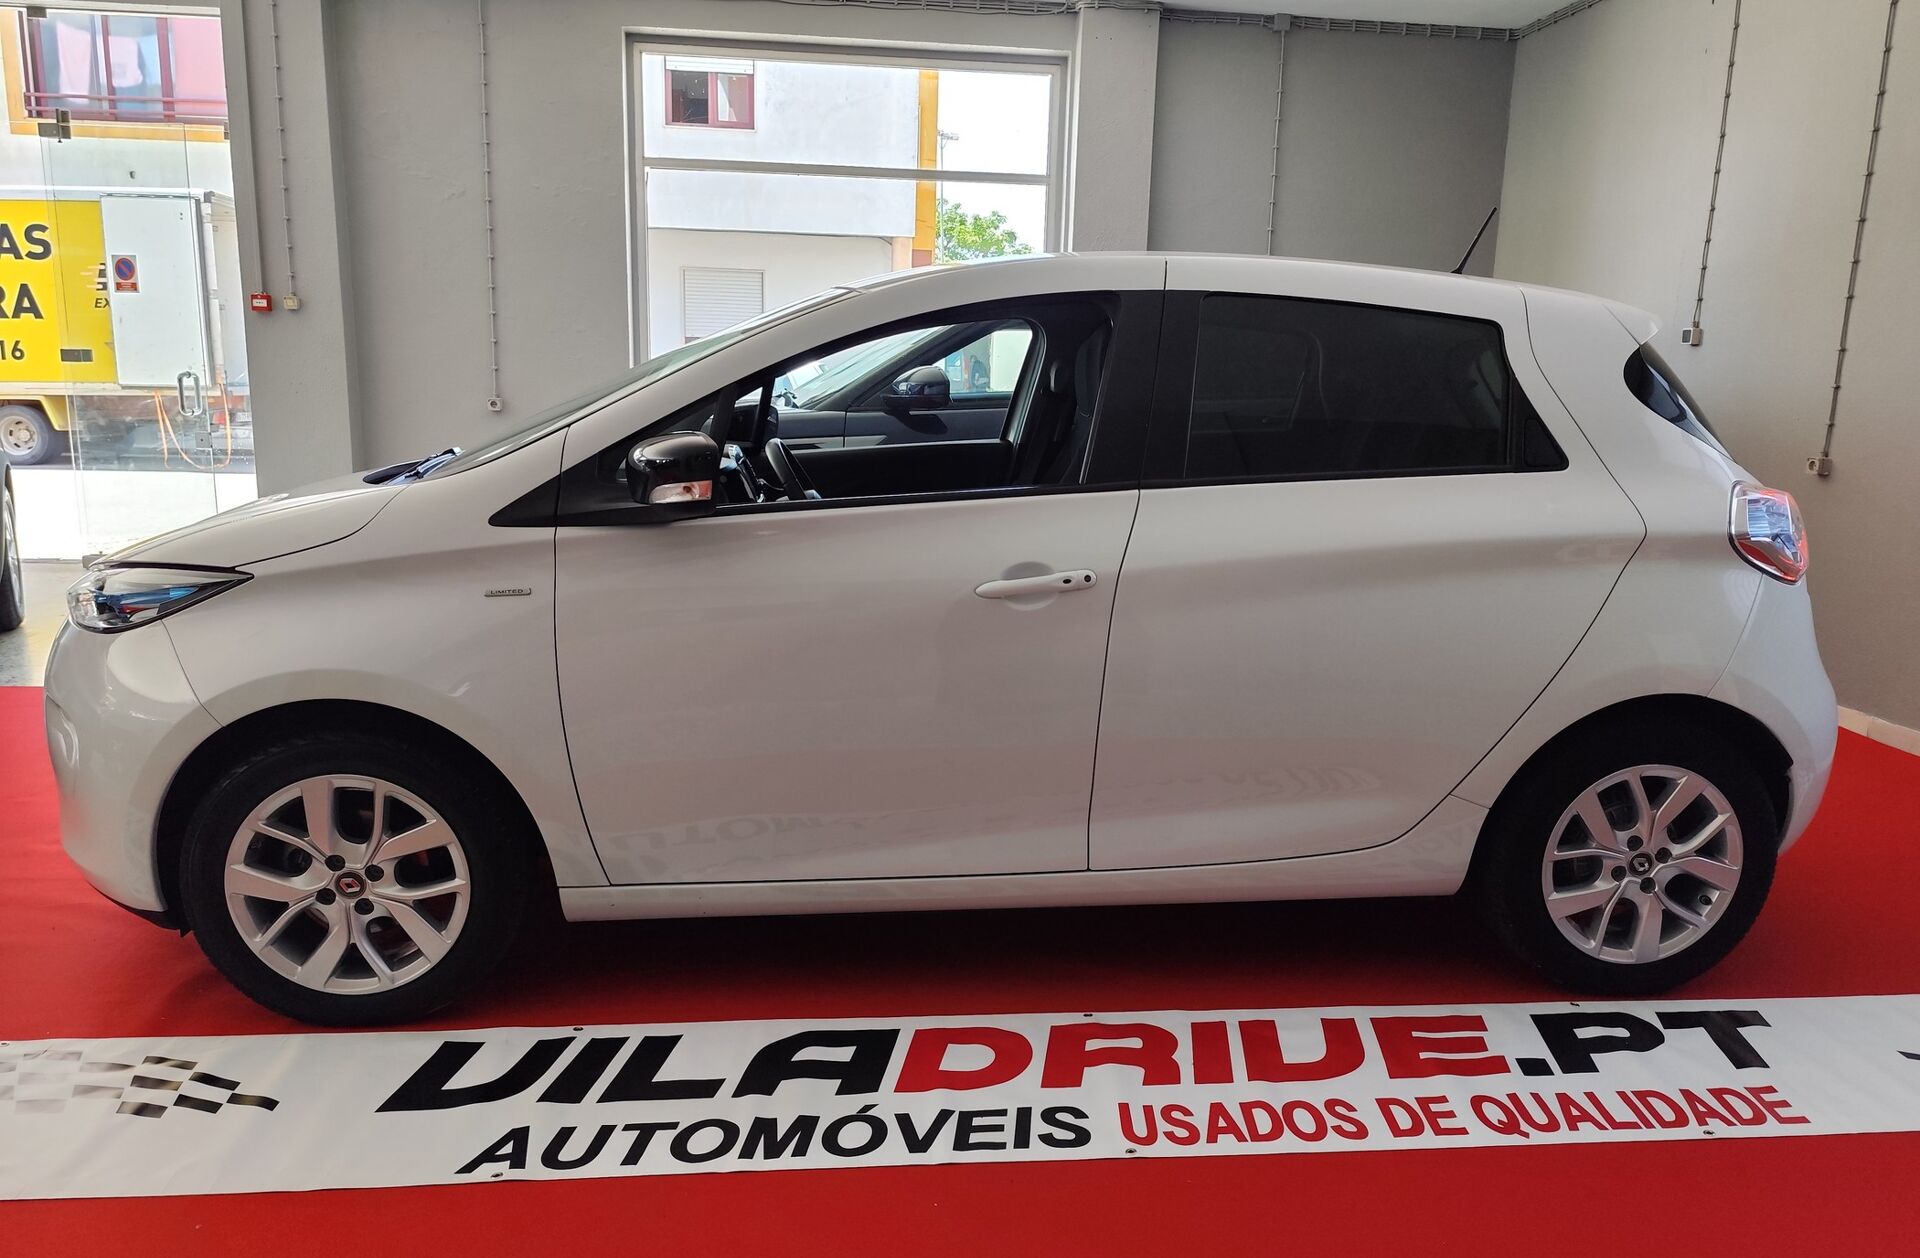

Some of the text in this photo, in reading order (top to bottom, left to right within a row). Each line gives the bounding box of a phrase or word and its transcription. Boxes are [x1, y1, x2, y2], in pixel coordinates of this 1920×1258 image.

[0, 223, 52, 260] AS
[455, 1085, 1811, 1174] AUTOMÓVEIS USADOS DE QUALIDADE
